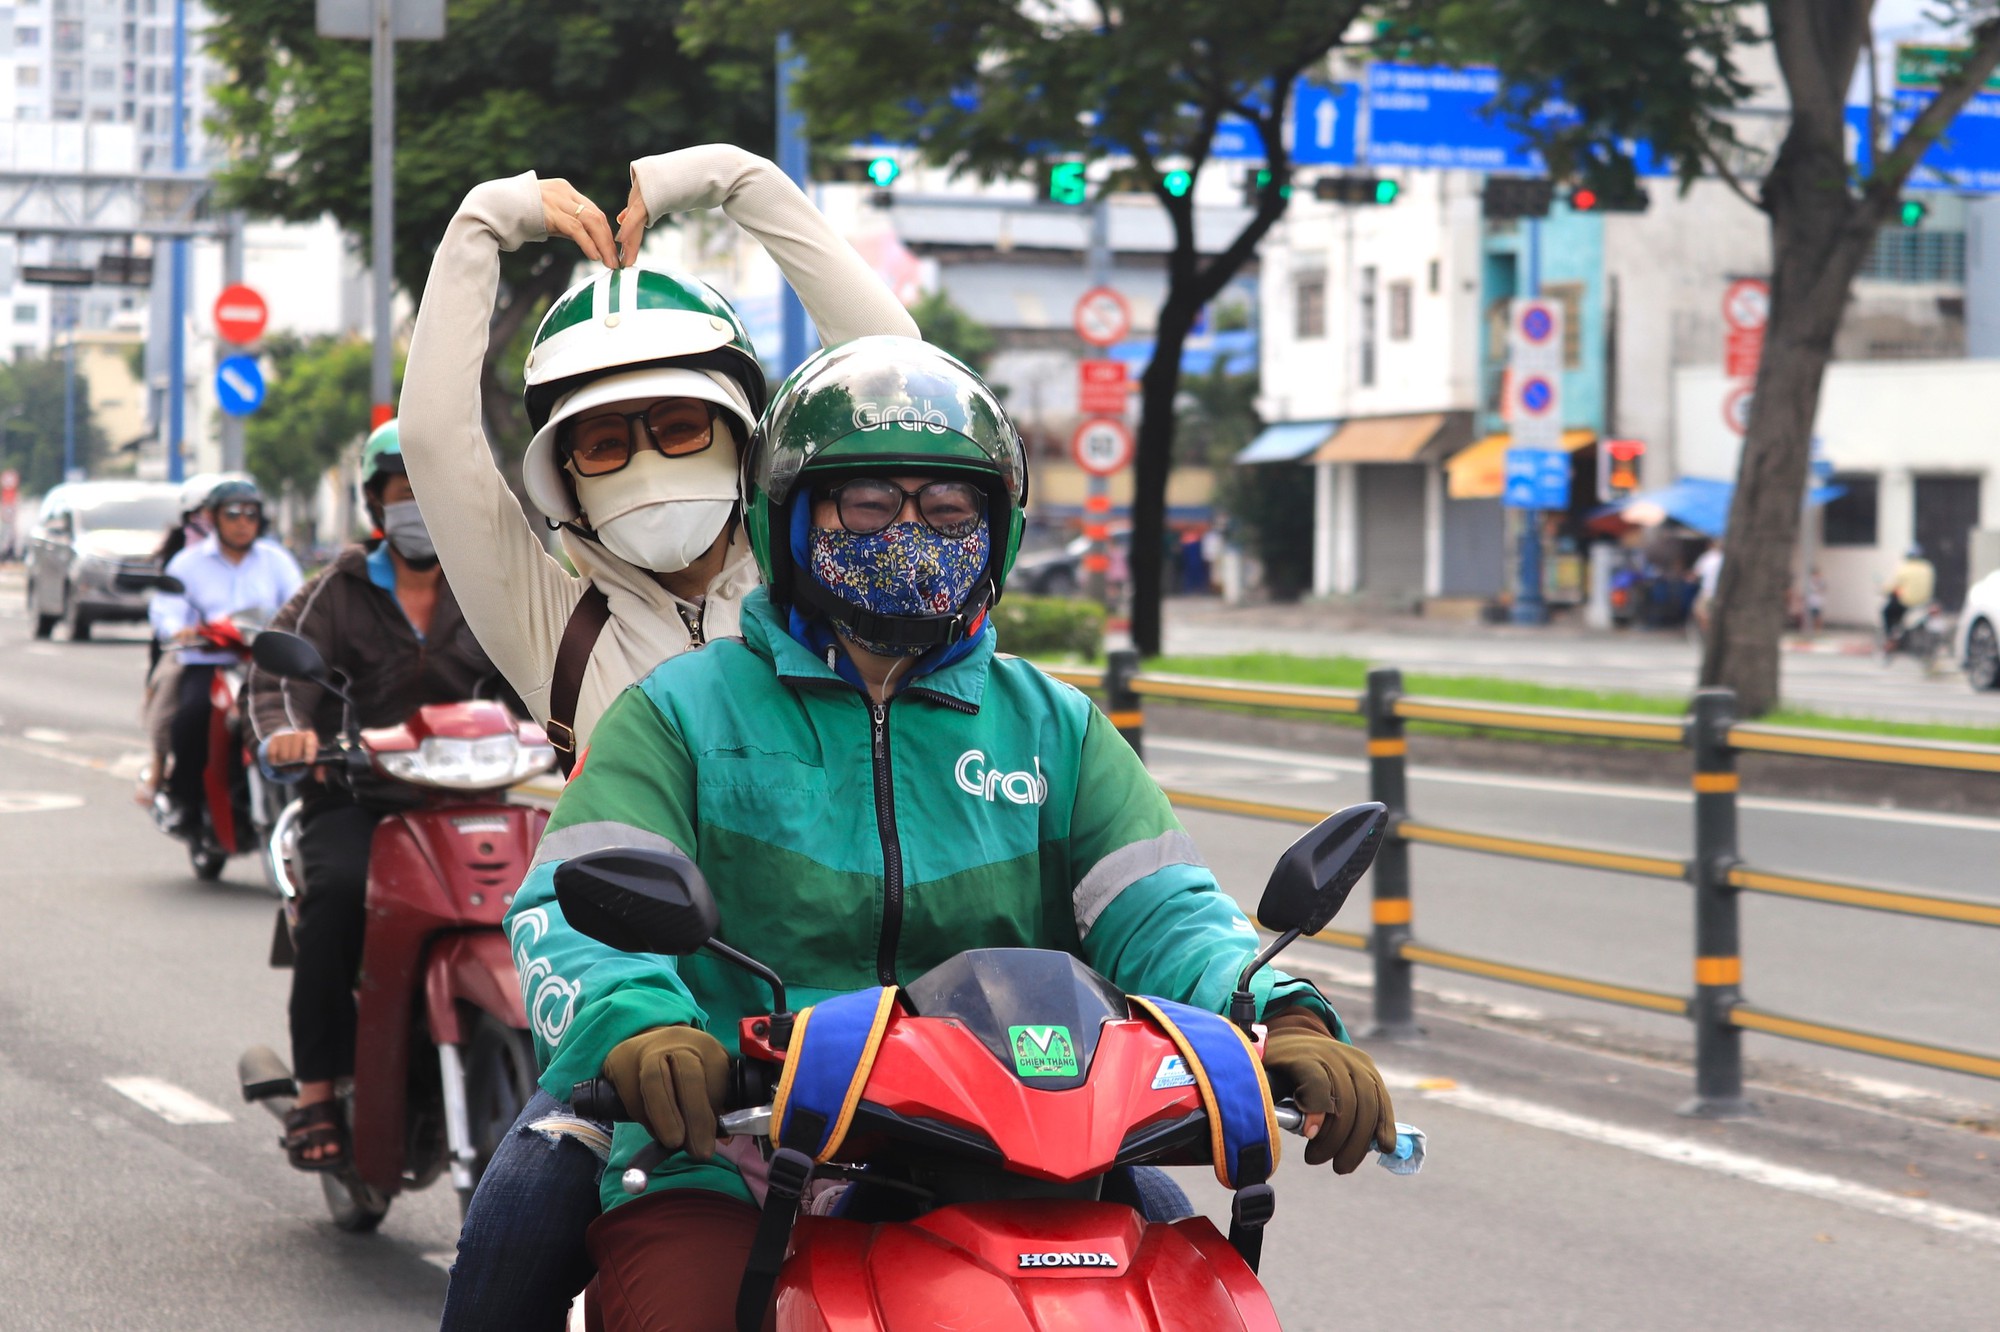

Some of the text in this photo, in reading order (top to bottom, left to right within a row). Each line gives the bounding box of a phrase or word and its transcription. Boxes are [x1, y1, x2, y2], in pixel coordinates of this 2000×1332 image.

[852, 400, 948, 435] Grab
[954, 749, 1049, 807] Grab
[1018, 1252, 1119, 1267] HONDA
